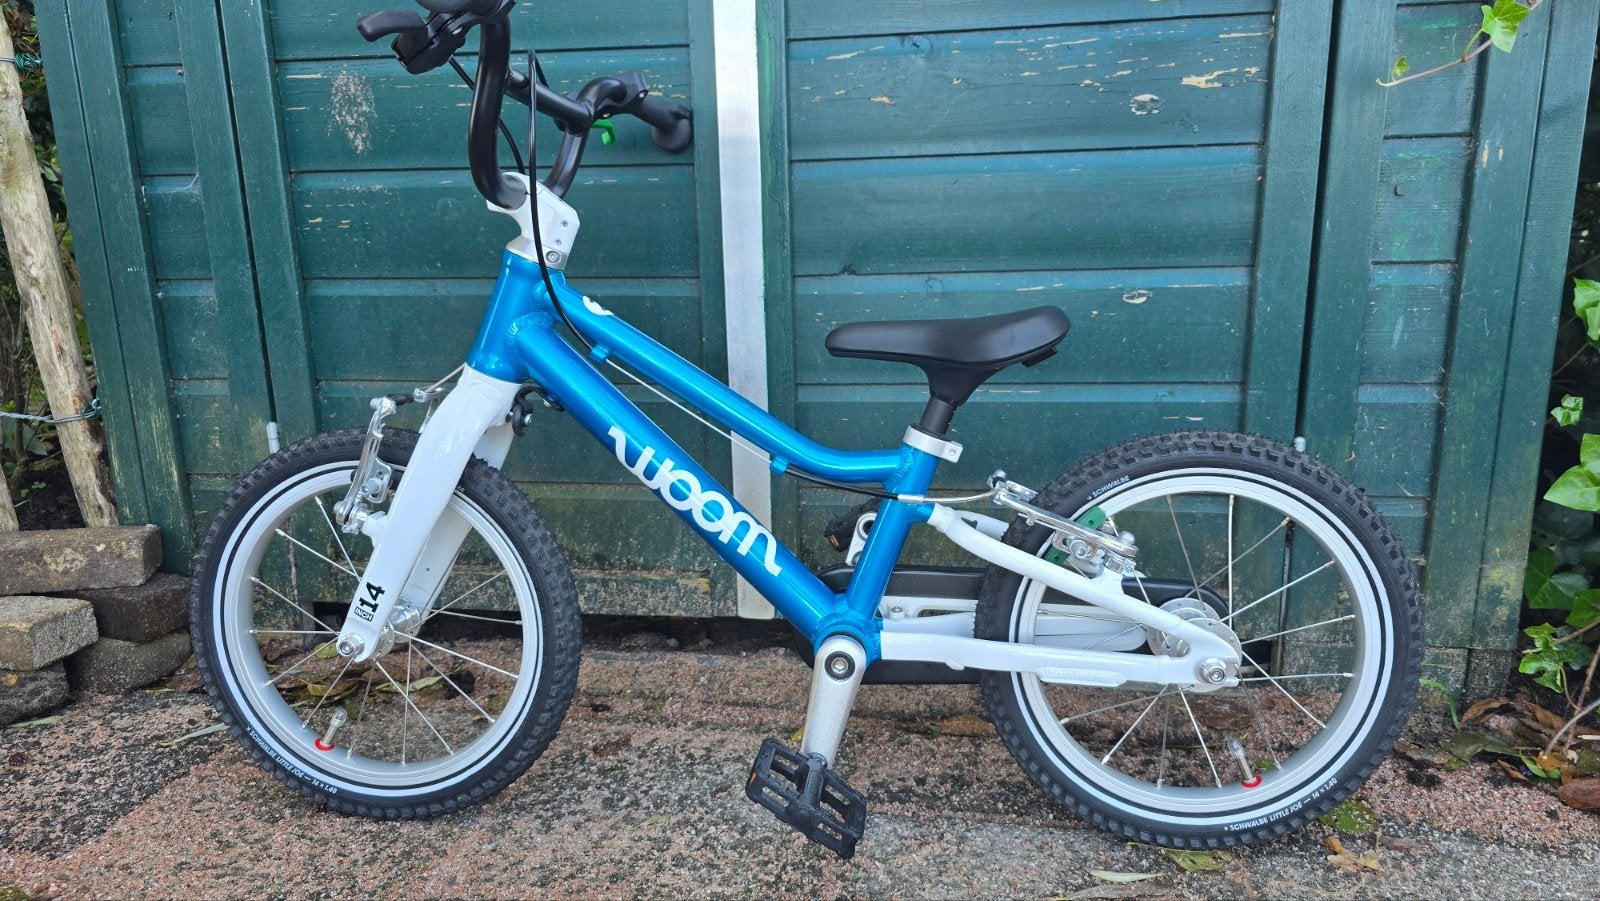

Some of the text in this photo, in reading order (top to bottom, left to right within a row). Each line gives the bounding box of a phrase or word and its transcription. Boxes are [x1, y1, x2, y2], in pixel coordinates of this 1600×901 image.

[607, 425, 782, 577] woom
[1092, 475, 1130, 498] SCHWALBE
[354, 606, 374, 621] INCH
[359, 581, 385, 613] 14
[249, 730, 278, 758] SCHWALBE
[275, 756, 294, 771] LITTLE
[292, 767, 305, 778] JOE
[311, 779, 320, 787] 14
[324, 785, 338, 794] 1.40
[1229, 817, 1269, 831] SCHWALBE
[1269, 808, 1290, 822] LITTLE
[1290, 801, 1303, 813] JOE
[1311, 790, 1320, 800] 14
[1324, 777, 1339, 791] 1.40
